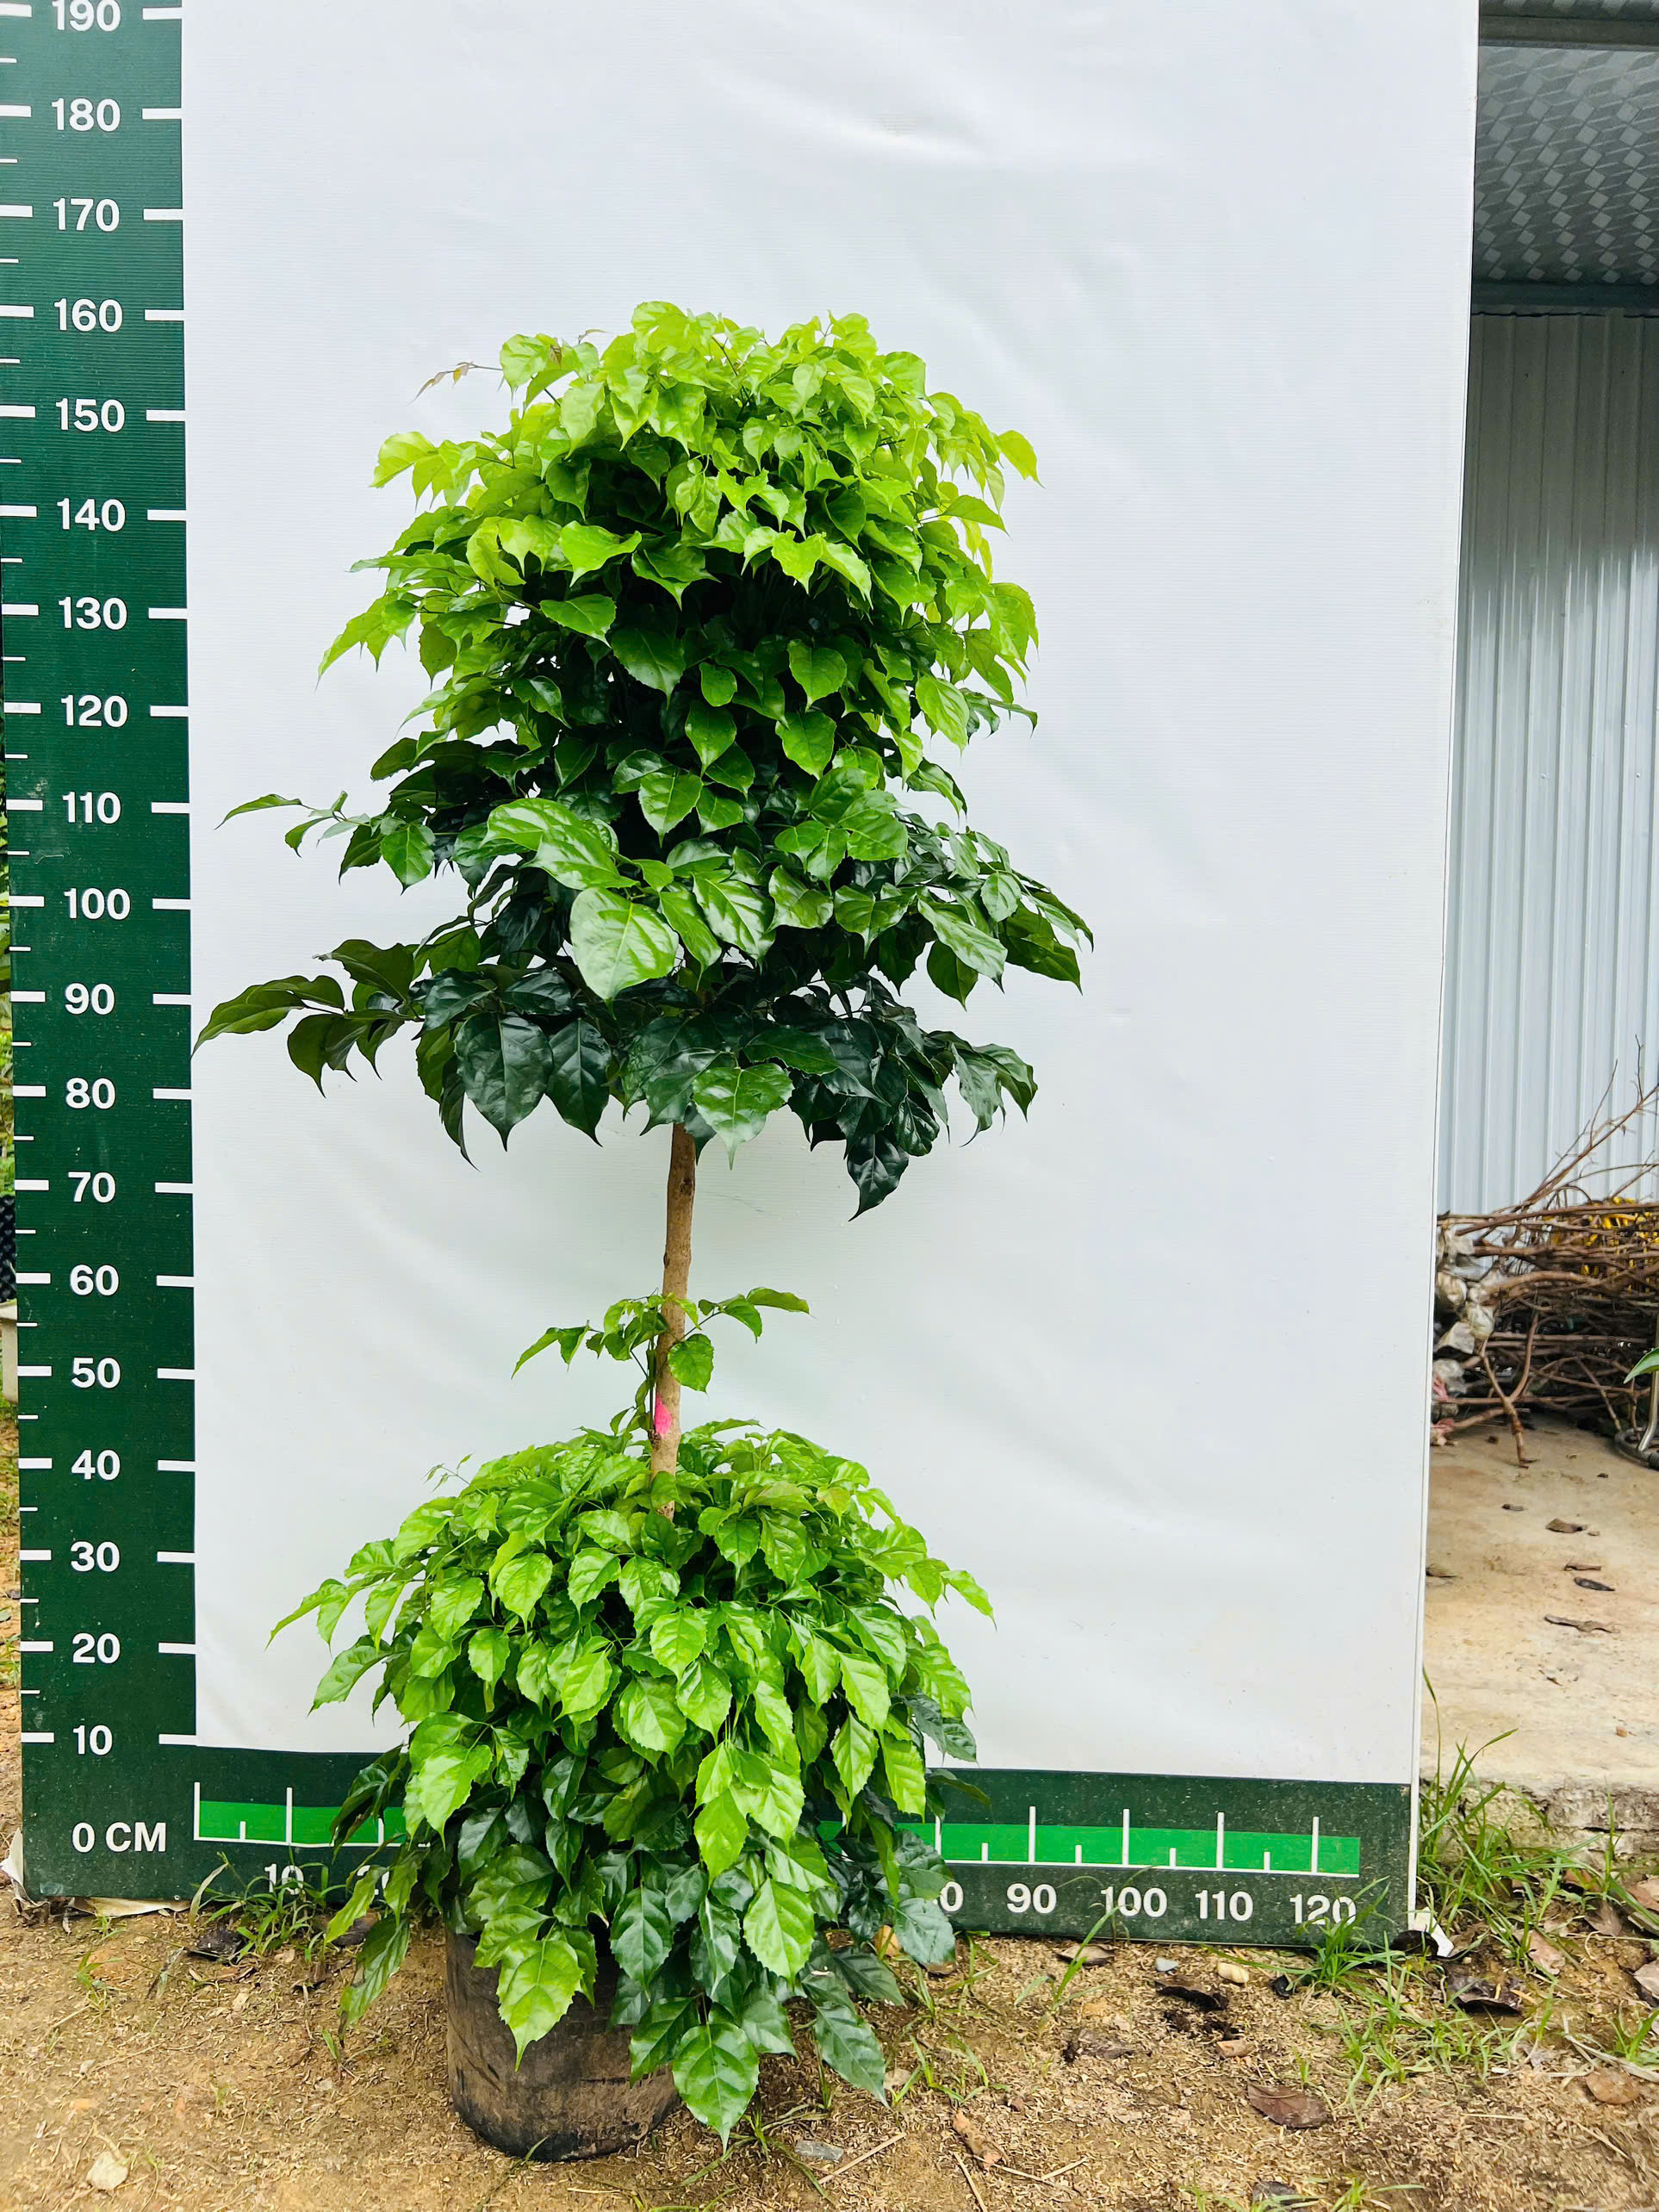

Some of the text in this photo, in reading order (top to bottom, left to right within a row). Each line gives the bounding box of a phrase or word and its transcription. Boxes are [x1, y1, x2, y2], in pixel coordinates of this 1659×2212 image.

[51, 0, 121, 32] 190
[51, 97, 121, 132] 180
[53, 197, 120, 232] 170
[53, 298, 123, 332] 160
[55, 397, 125, 432] 150
[57, 497, 126, 531] 140
[58, 596, 127, 631] 130
[60, 694, 128, 728] 120
[62, 791, 121, 824] 110
[64, 887, 131, 920] 100
[65, 983, 115, 1016] 90
[65, 1077, 115, 1109] 80
[68, 1171, 116, 1203] 70
[70, 1264, 119, 1296] 60
[71, 1357, 121, 1389] 50
[71, 1450, 121, 1481] 40
[71, 1541, 120, 1572] 30
[72, 1632, 121, 1664] 20
[72, 1724, 113, 1755] 10
[71, 1822, 166, 1853] 0 CM
[264, 1863, 1357, 1926] 10 0 90 100 110 120
